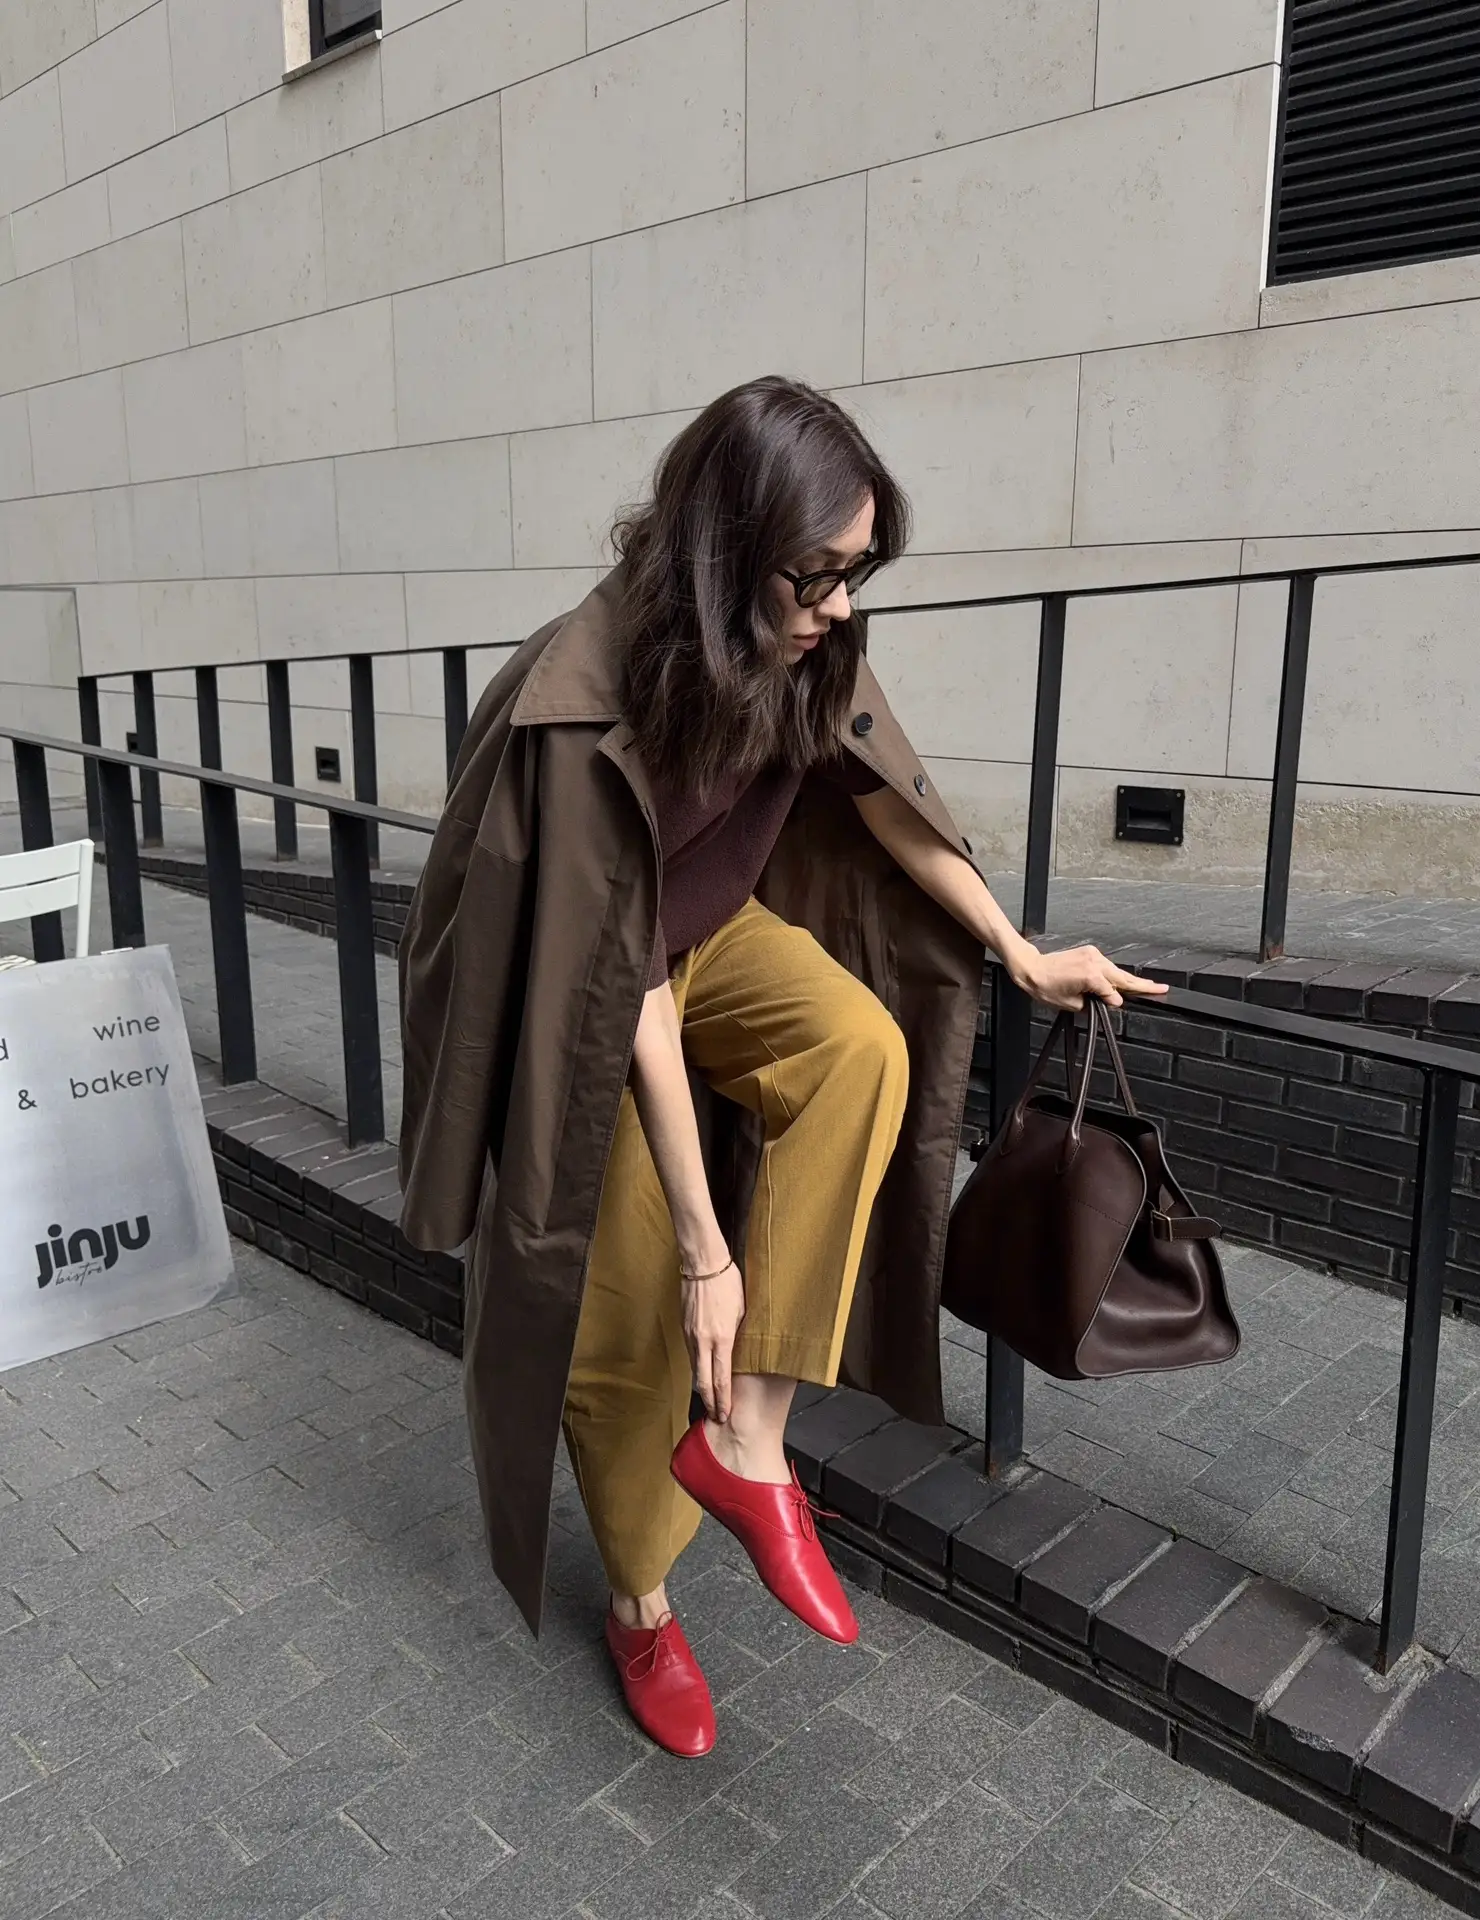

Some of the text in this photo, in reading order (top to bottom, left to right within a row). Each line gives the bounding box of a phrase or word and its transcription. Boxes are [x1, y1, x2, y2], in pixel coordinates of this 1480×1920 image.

[92, 1015, 161, 1041] wine
[18, 1063, 170, 1110] & bakery
